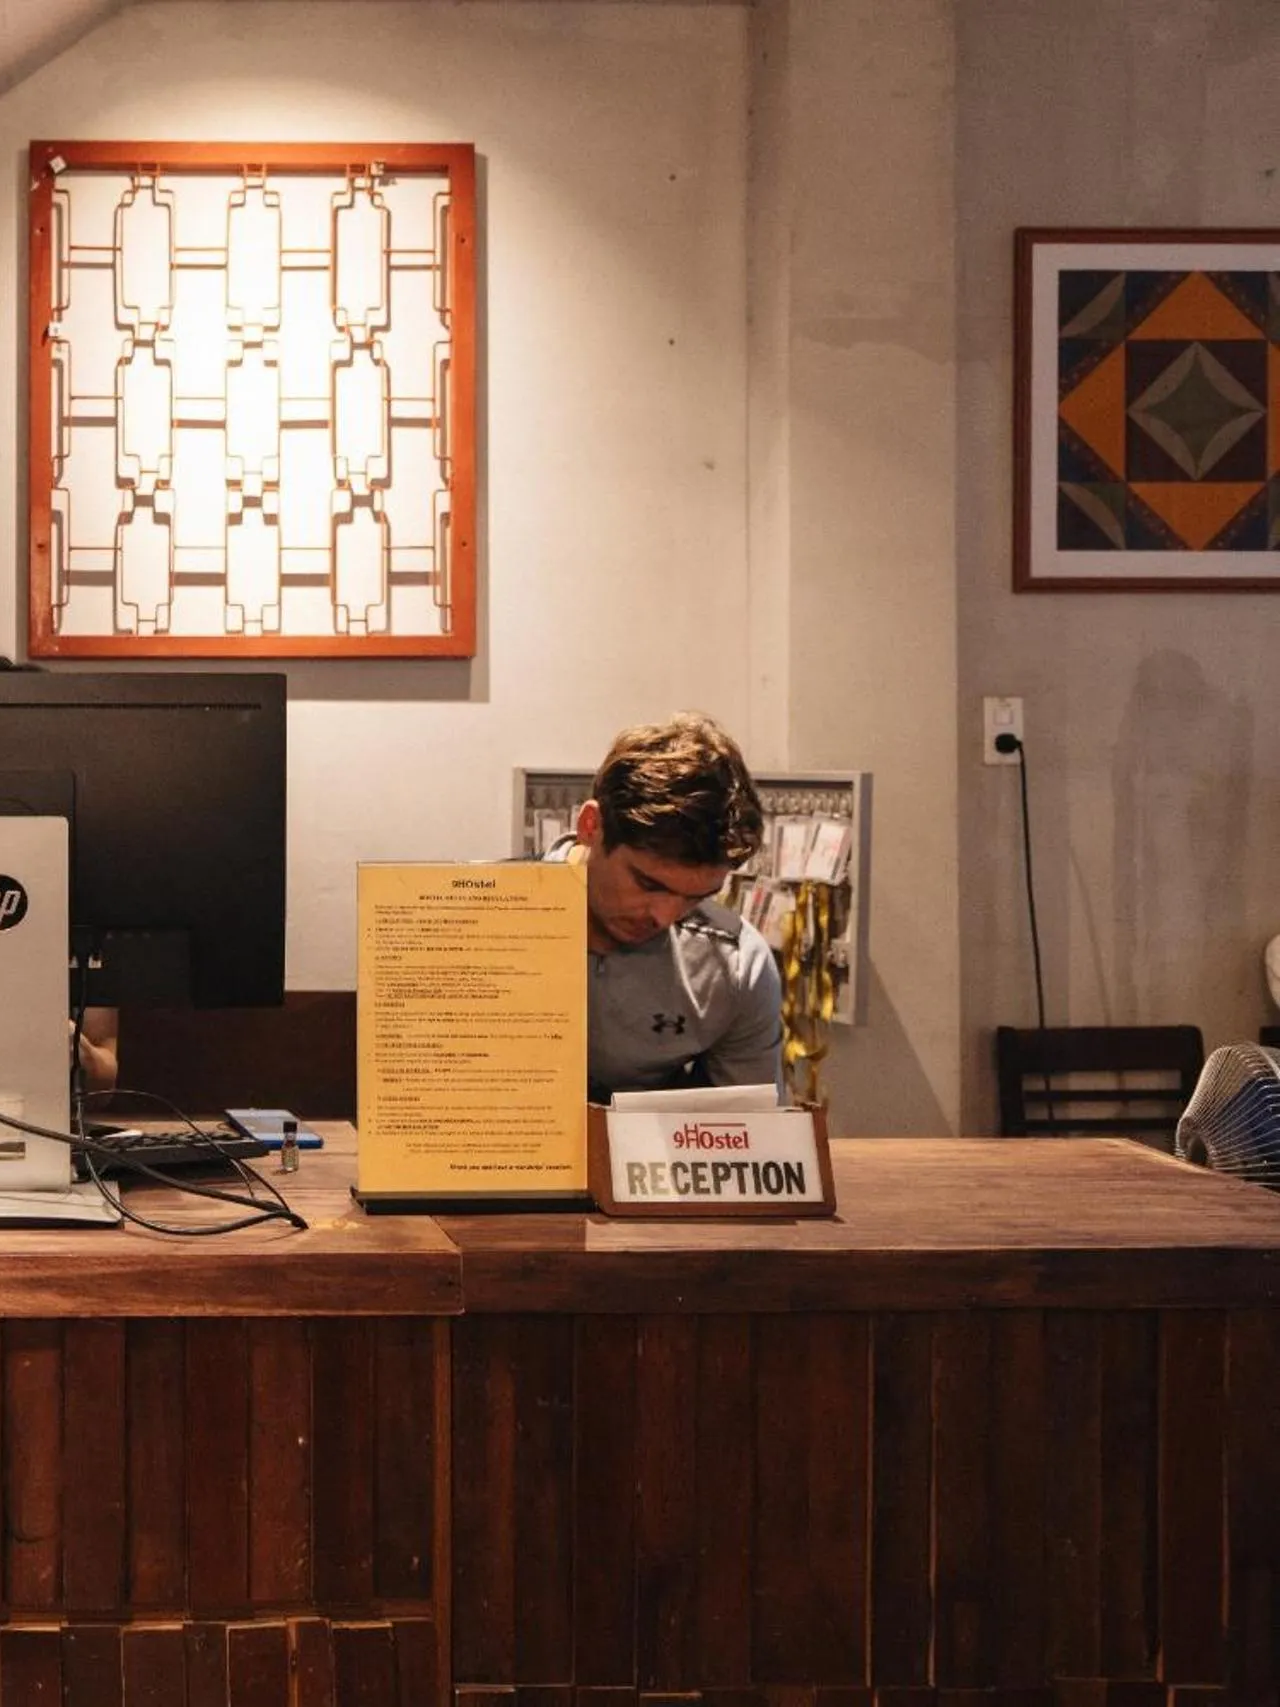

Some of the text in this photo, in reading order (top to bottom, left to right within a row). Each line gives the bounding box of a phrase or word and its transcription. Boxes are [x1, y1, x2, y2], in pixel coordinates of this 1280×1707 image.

[451, 880, 496, 889] 9HOstel
[673, 1123, 749, 1150] 9HOstel
[626, 1161, 806, 1196] RECEPTION
